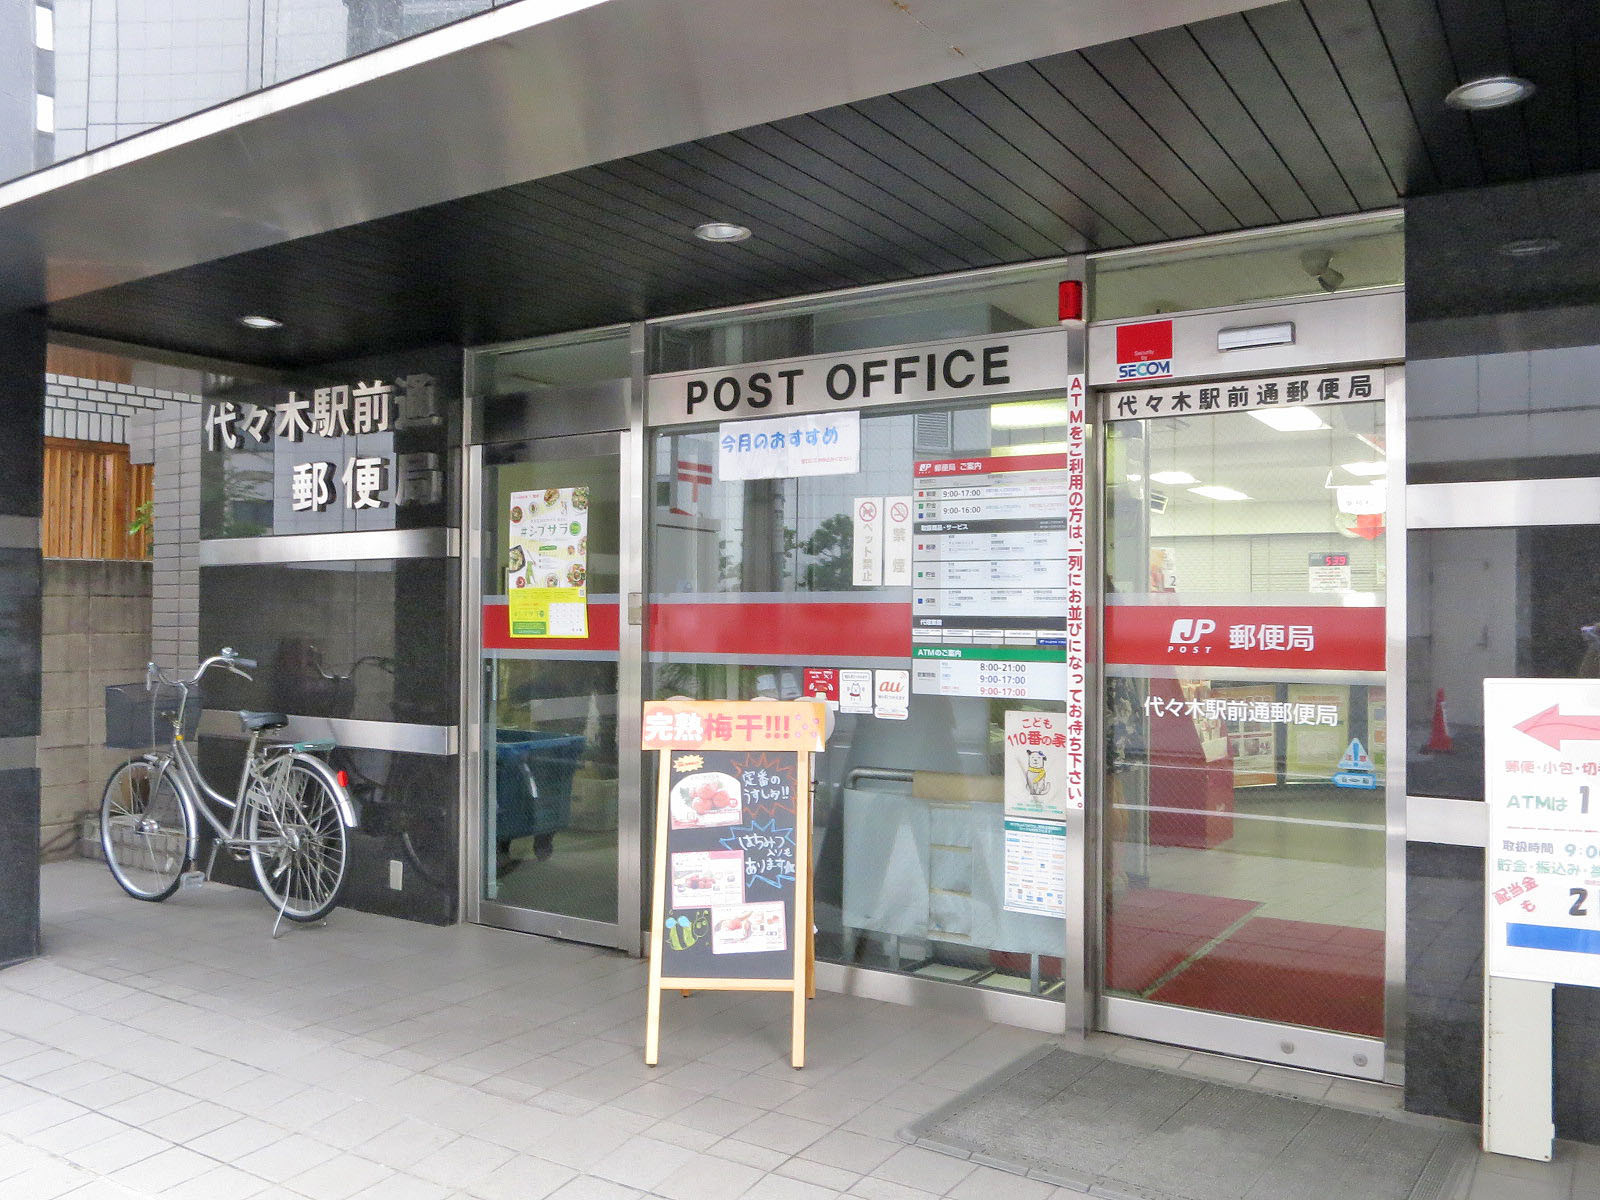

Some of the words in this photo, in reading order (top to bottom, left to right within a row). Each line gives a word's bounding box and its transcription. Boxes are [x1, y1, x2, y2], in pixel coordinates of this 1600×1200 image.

[1119, 360, 1171, 379] SECOM
[686, 369, 804, 415] POST
[826, 345, 1011, 401] OFFICE
[1117, 373, 1373, 417] 代々木駅前通郵便局
[721, 426, 839, 453] 今月のおすすめ
[942, 489, 982, 499] 9:00-17:00
[943, 506, 982, 515] 9:00-16:00
[1229, 624, 1315, 652] 郵便局
[1167, 645, 1212, 654] POST
[980, 662, 1026, 673] 8:00-21:00
[880, 681, 904, 693] au
[980, 675, 1026, 685] 9:00-17:00
[980, 687, 1026, 697] 9:00-17:00
[1144, 695, 1339, 727] 代々木駅前通郵便局
[1022, 717, 1053, 730] こども
[742, 768, 781, 788] 定番の
[1504, 760, 1600, 777] 郵便・小包・切
[1506, 794, 1569, 813] ATMは
[739, 833, 785, 852] はちみつ
[1502, 839, 1554, 855] 取扱時間
[1564, 843, 1600, 859] 9:0
[1492, 876, 1540, 906] 配当金
[1520, 899, 1537, 913] も
[1568, 887, 1589, 917] 2
